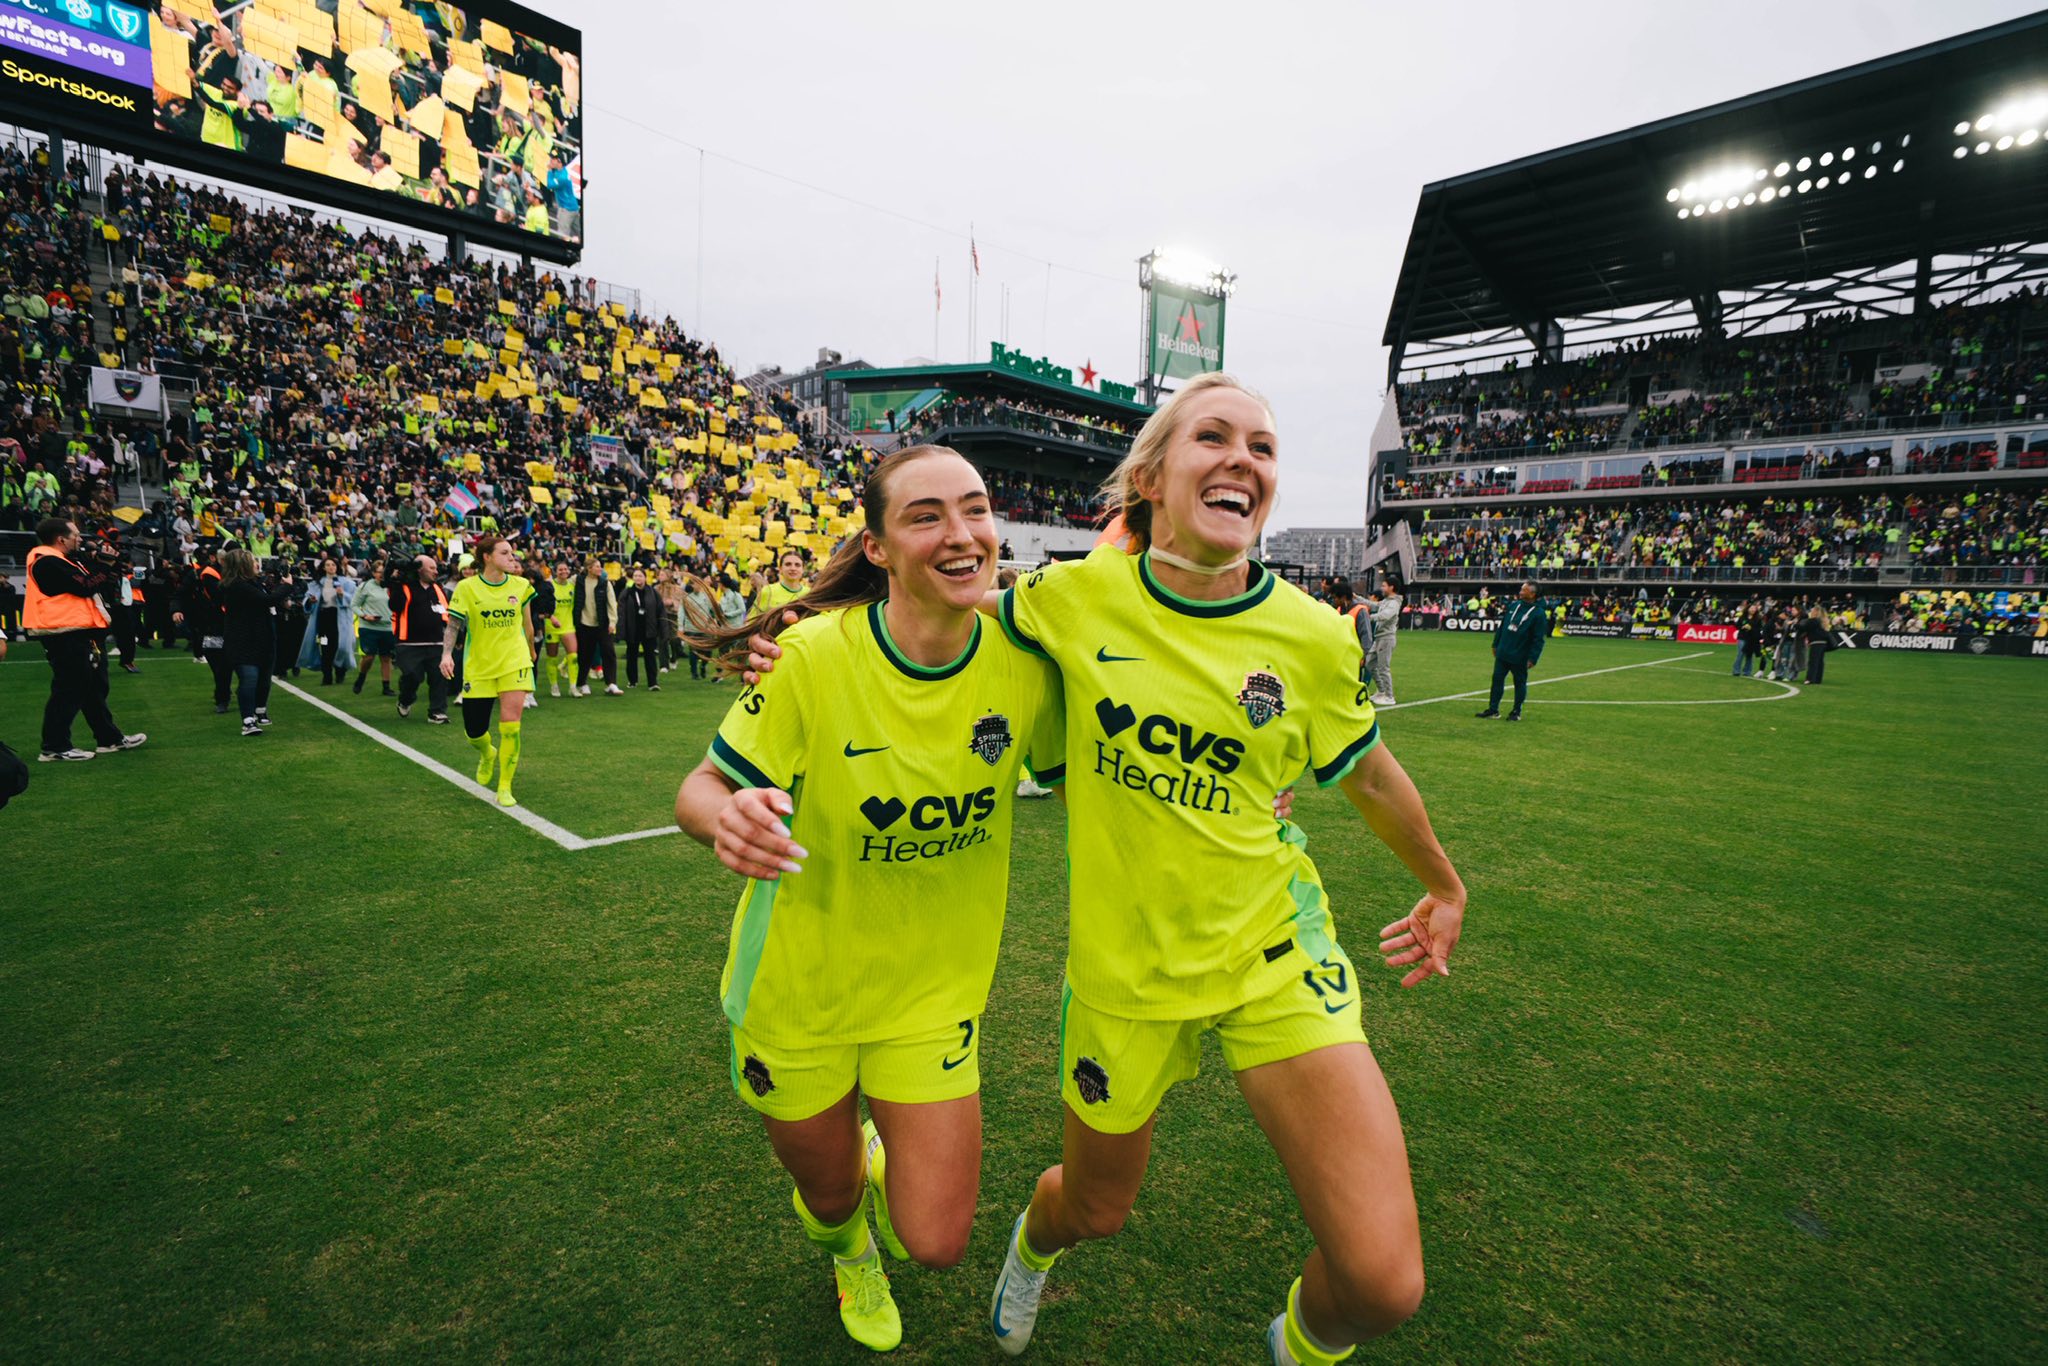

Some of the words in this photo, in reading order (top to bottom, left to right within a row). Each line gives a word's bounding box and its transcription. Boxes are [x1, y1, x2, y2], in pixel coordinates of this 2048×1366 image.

[6, 30, 69, 57] BEVERAGE
[2, 59, 136, 112] Sportsbook
[1158, 332, 1219, 362] Heineken
[991, 341, 1073, 385] Heineken
[492, 609, 516, 618] CVS
[1683, 627, 1728, 640] Audi
[1869, 634, 1957, 650] @WASHSPIRIT
[519, 668, 528, 679] 17
[977, 733, 1006, 745] SPIRIT
[1138, 714, 1246, 774] CVS
[1094, 740, 1231, 814] Health
[909, 786, 995, 831] CVS
[859, 826, 988, 862] Health
[958, 1019, 974, 1049] 7
